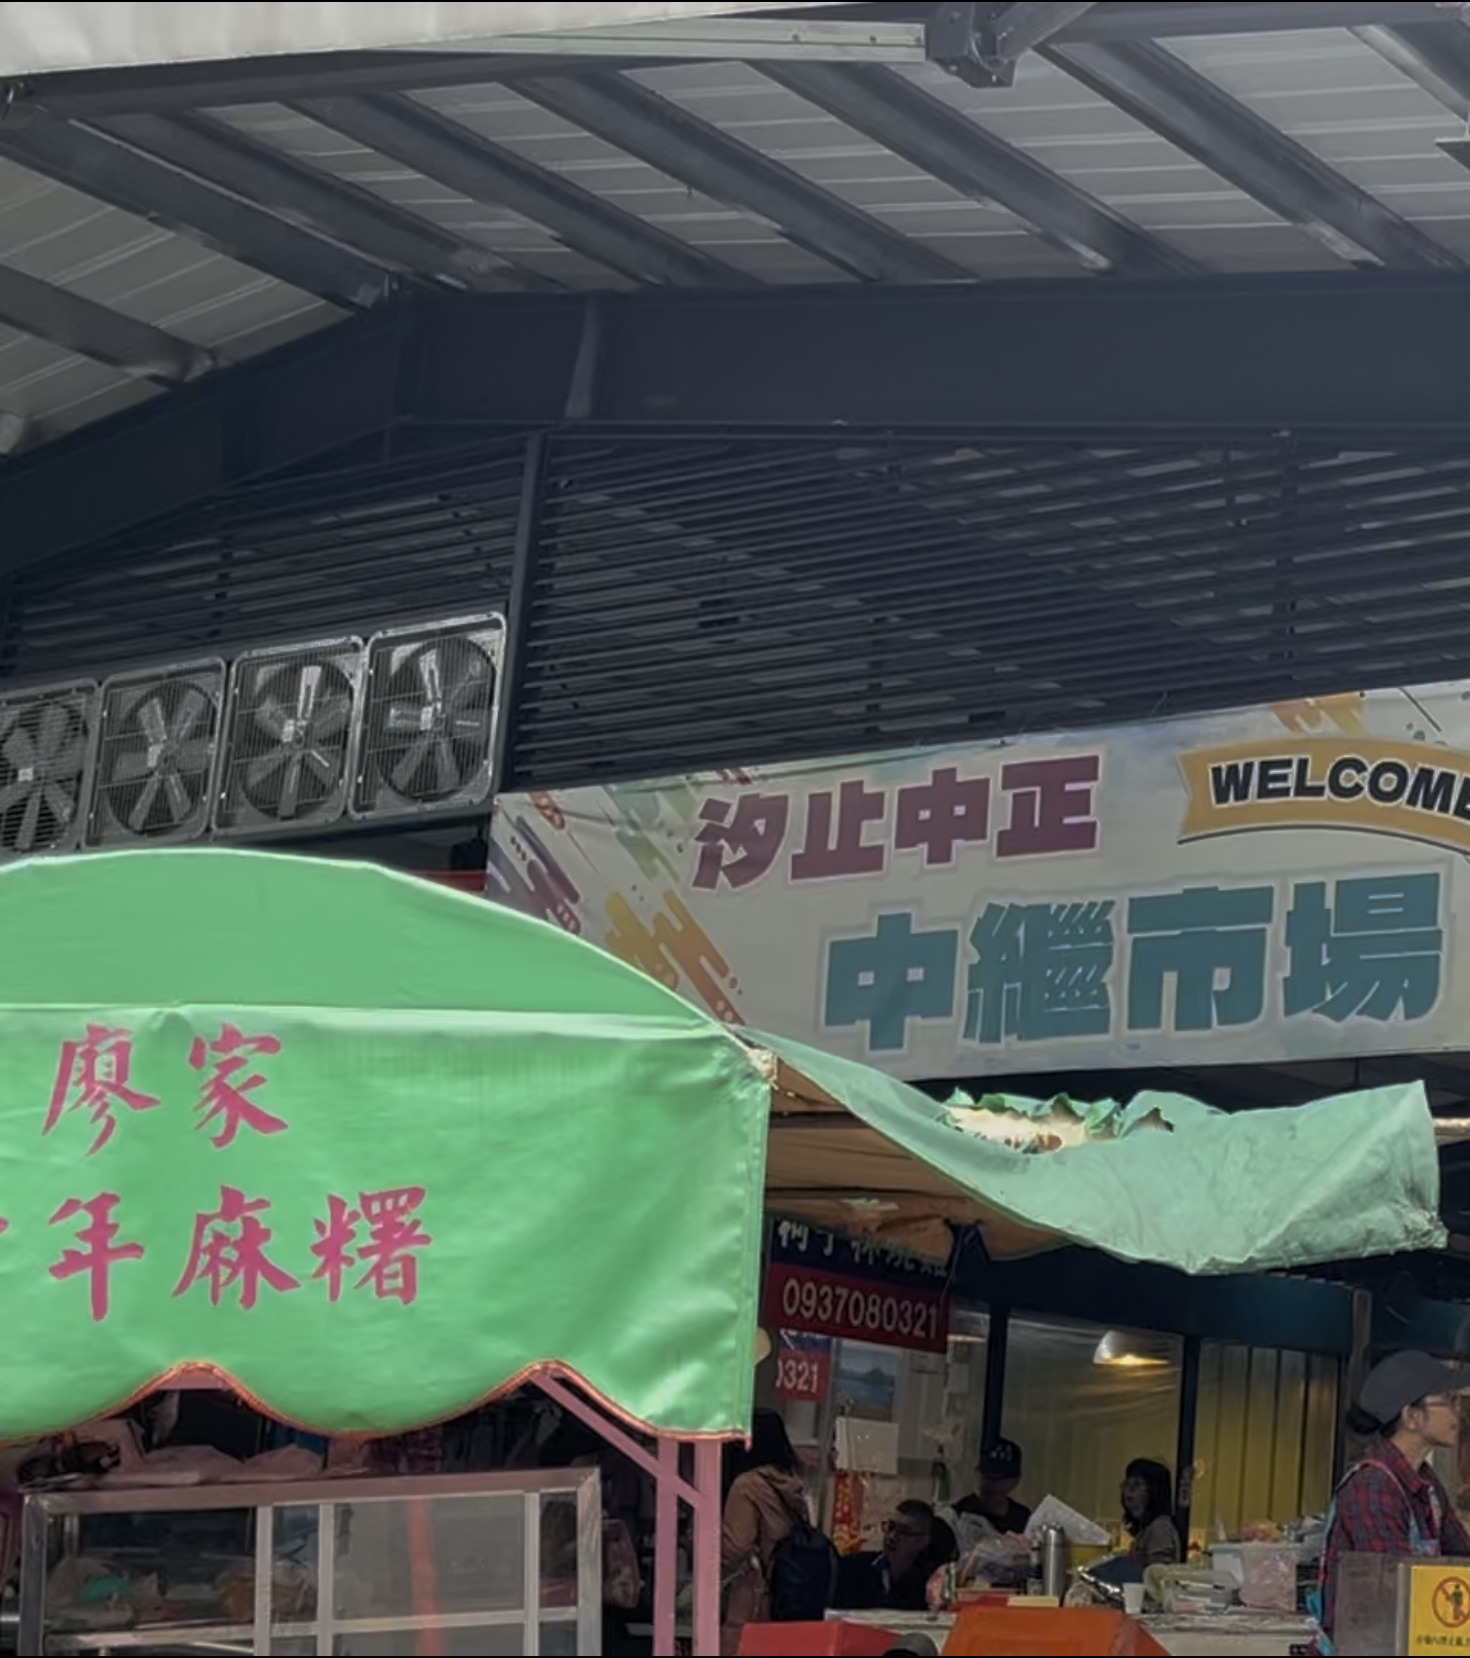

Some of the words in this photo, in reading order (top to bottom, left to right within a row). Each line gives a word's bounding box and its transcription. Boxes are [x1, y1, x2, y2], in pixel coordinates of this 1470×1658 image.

[692, 755, 1099, 889] 汐止中正
[825, 872, 1443, 1051] 中繼市場
[42, 1023, 288, 1157] 廖家
[0, 1185, 432, 1322] 年麻糬
[783, 1277, 938, 1339] 0937080321
